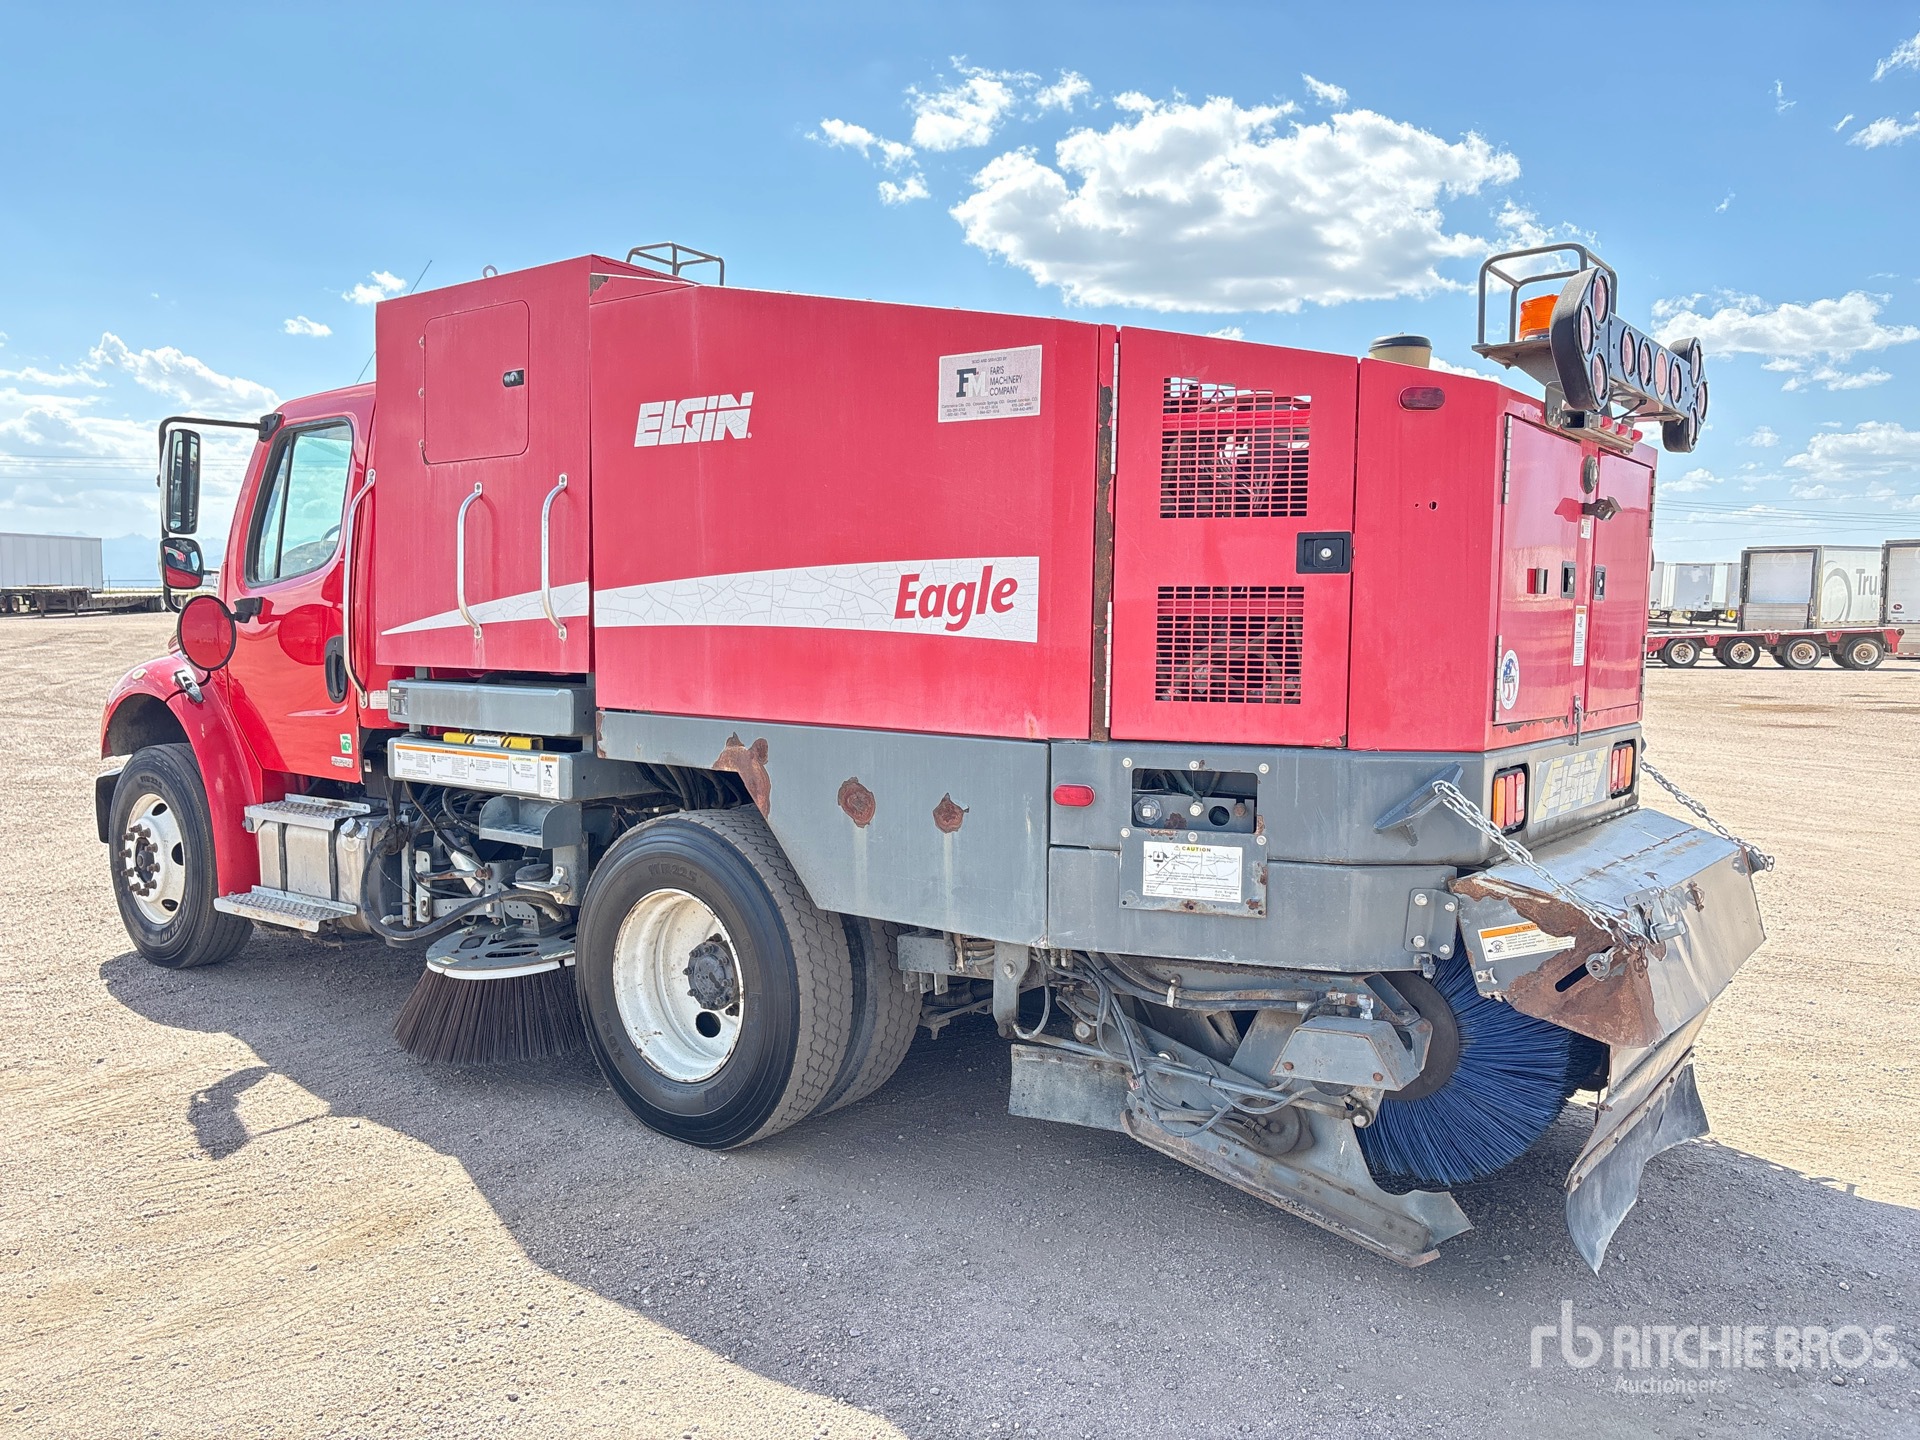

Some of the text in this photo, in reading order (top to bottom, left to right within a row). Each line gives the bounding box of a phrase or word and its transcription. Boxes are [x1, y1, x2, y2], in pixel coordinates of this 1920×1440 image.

[990, 366, 1004, 375] FARIS
[990, 375, 1022, 386] MACHINERY
[989, 386, 1018, 396] COMPANY
[634, 391, 752, 447] ELGIN
[1856, 568, 1879, 596] Tru
[894, 565, 1018, 632] Eagle
